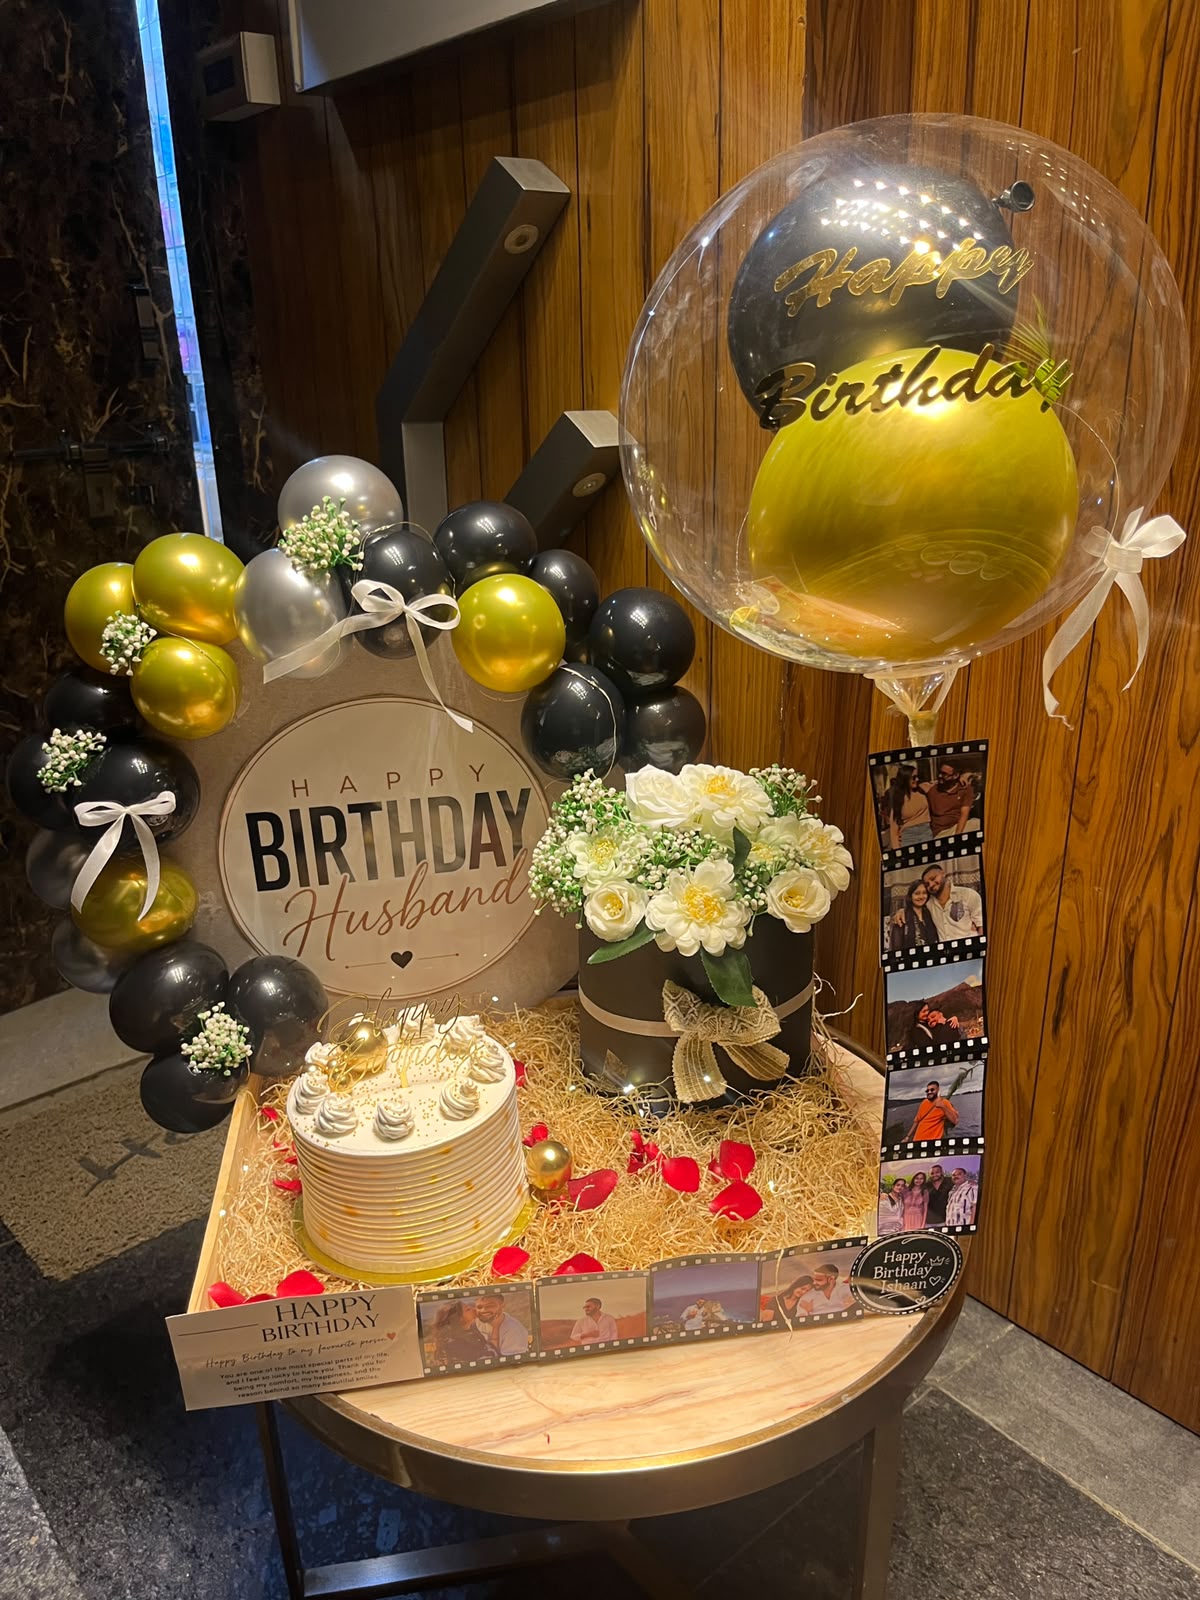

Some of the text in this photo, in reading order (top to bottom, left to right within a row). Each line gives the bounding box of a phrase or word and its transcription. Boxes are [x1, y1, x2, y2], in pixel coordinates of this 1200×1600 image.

[773, 237, 1035, 318] Happy
[754, 343, 1074, 431] Birthday
[291, 763, 485, 798] HAPPY
[245, 787, 532, 893] BIRTHDAY
[282, 848, 531, 961] Husband
[316, 987, 464, 1043] Happy
[873, 1264, 933, 1280] Birthday
[883, 1250, 927, 1265] Happy
[880, 1279, 927, 1293] Ishaan
[275, 1295, 377, 1322] HAPPY
[261, 1313, 380, 1342] BIRTHDAY
[206, 1337, 387, 1368] Happy Birthday to my favourite person
[308, 1359, 334, 1368] special
[334, 1357, 353, 1365] parts
[338, 1362, 359, 1370] Thank
[362, 1360, 375, 1368] you
[238, 1390, 263, 1398] reason
[264, 1386, 290, 1394] behind
[301, 1382, 321, 1390] many
[322, 1377, 355, 1386] beautiful
